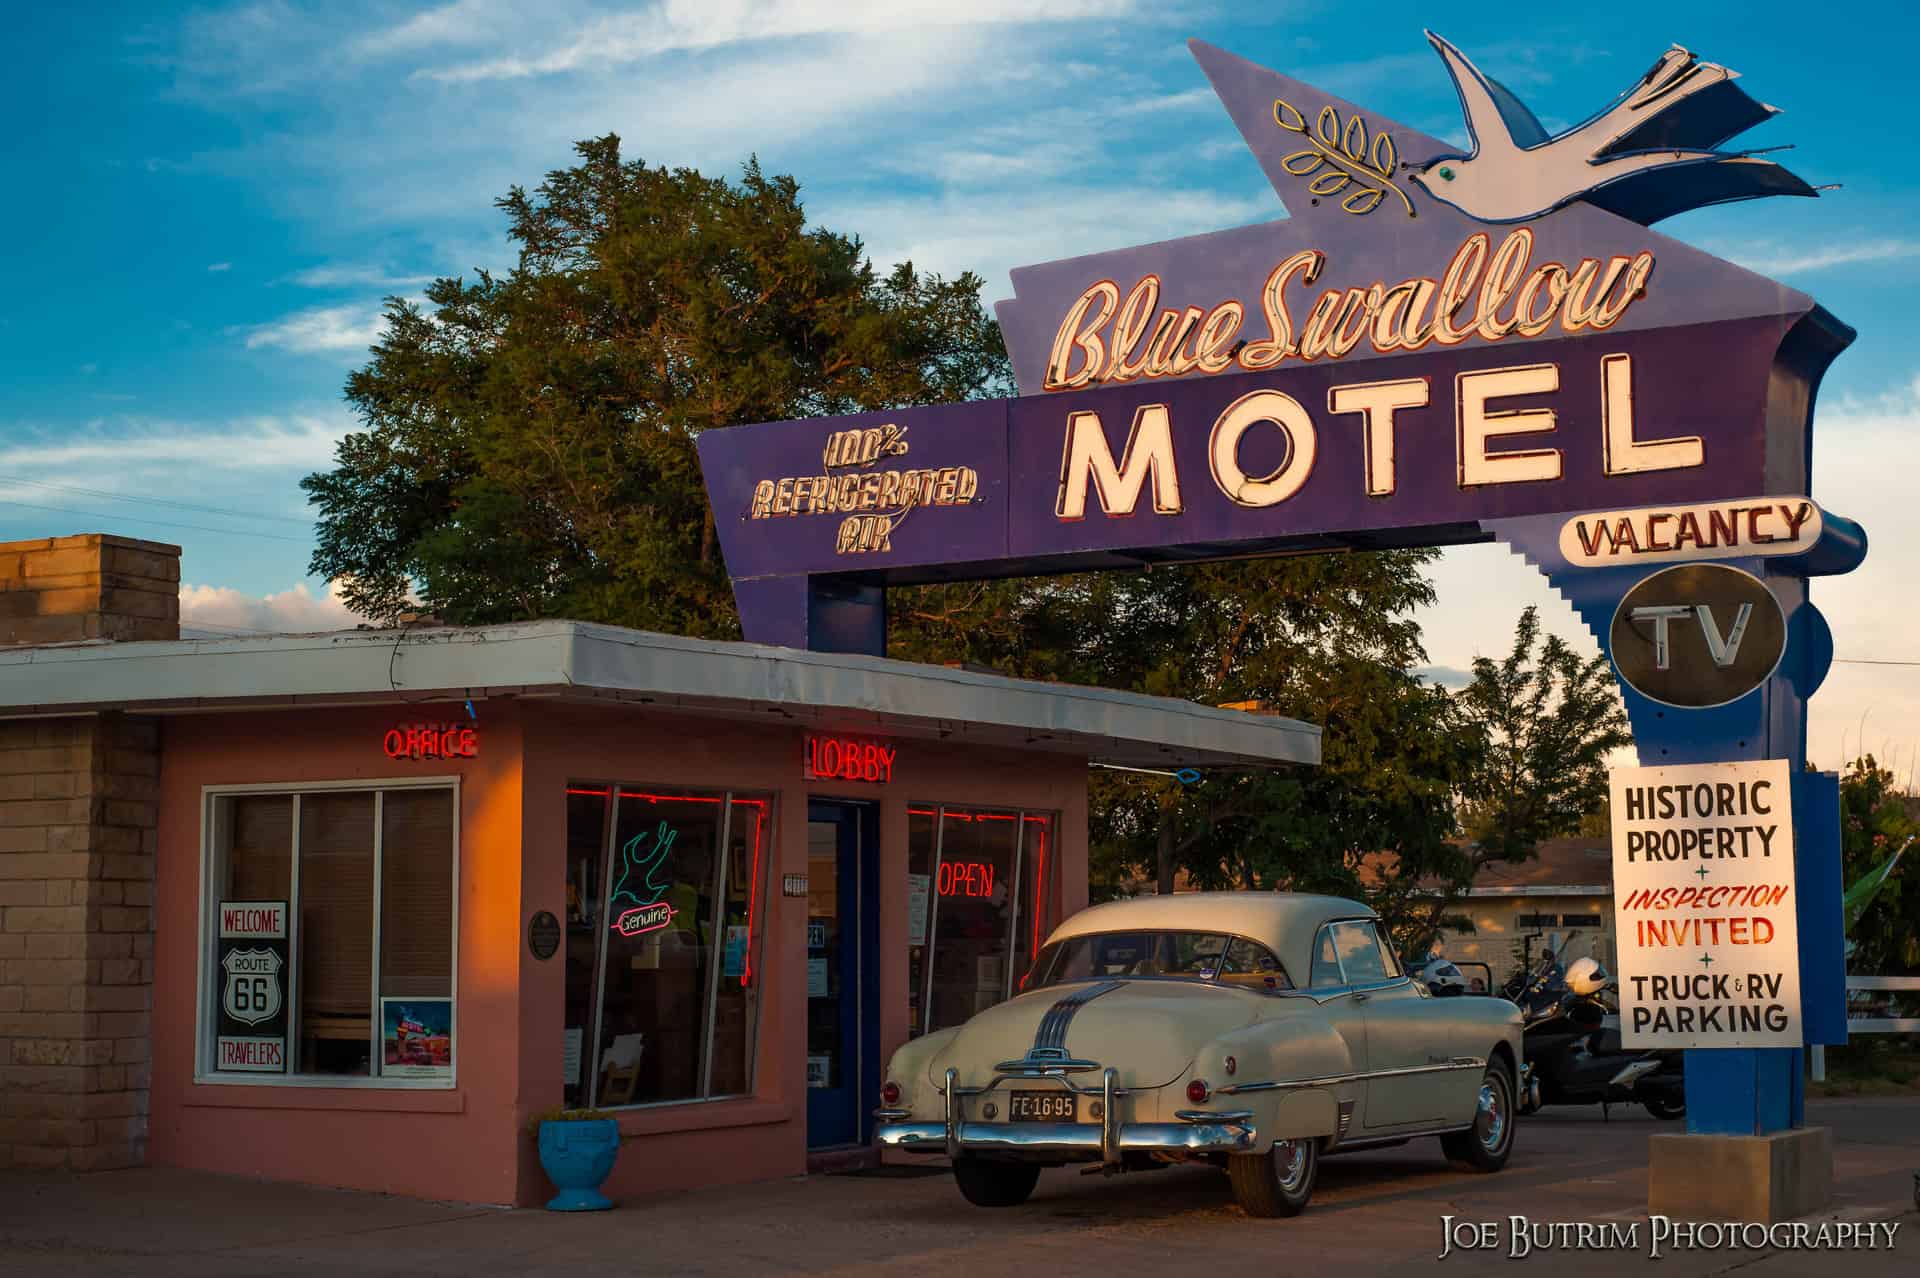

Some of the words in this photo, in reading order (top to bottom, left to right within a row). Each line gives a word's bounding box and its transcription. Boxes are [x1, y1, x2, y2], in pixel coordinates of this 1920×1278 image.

[1043, 274, 1245, 391] Blue
[1239, 227, 1655, 369] Swallow
[825, 424, 909, 467] 100%
[1055, 353, 1704, 520] MOTEL
[752, 466, 978, 519] REFRIGERATED
[836, 516, 892, 554] AIR
[1576, 502, 1812, 556] VACANCY
[1630, 602, 1752, 669] TV
[384, 729, 478, 759] OFFICE
[811, 737, 896, 782] LOBBY
[1625, 781, 1771, 820] HISTORIC
[1627, 825, 1778, 862] PROPERTY
[938, 863, 993, 897] OPEN
[1623, 885, 1788, 910] INSPECTION
[224, 908, 280, 932] WELCOME
[622, 907, 668, 931] Genuine
[1637, 917, 1774, 947] INVITED
[235, 959, 270, 971] ROUTE
[234, 978, 268, 1012] 66
[1631, 974, 1730, 1000] TRUCK
[1735, 979, 1743, 992] &
[1747, 974, 1782, 999] RV
[1633, 1004, 1788, 1033] PARKING
[221, 1041, 281, 1066] TRAVELERS
